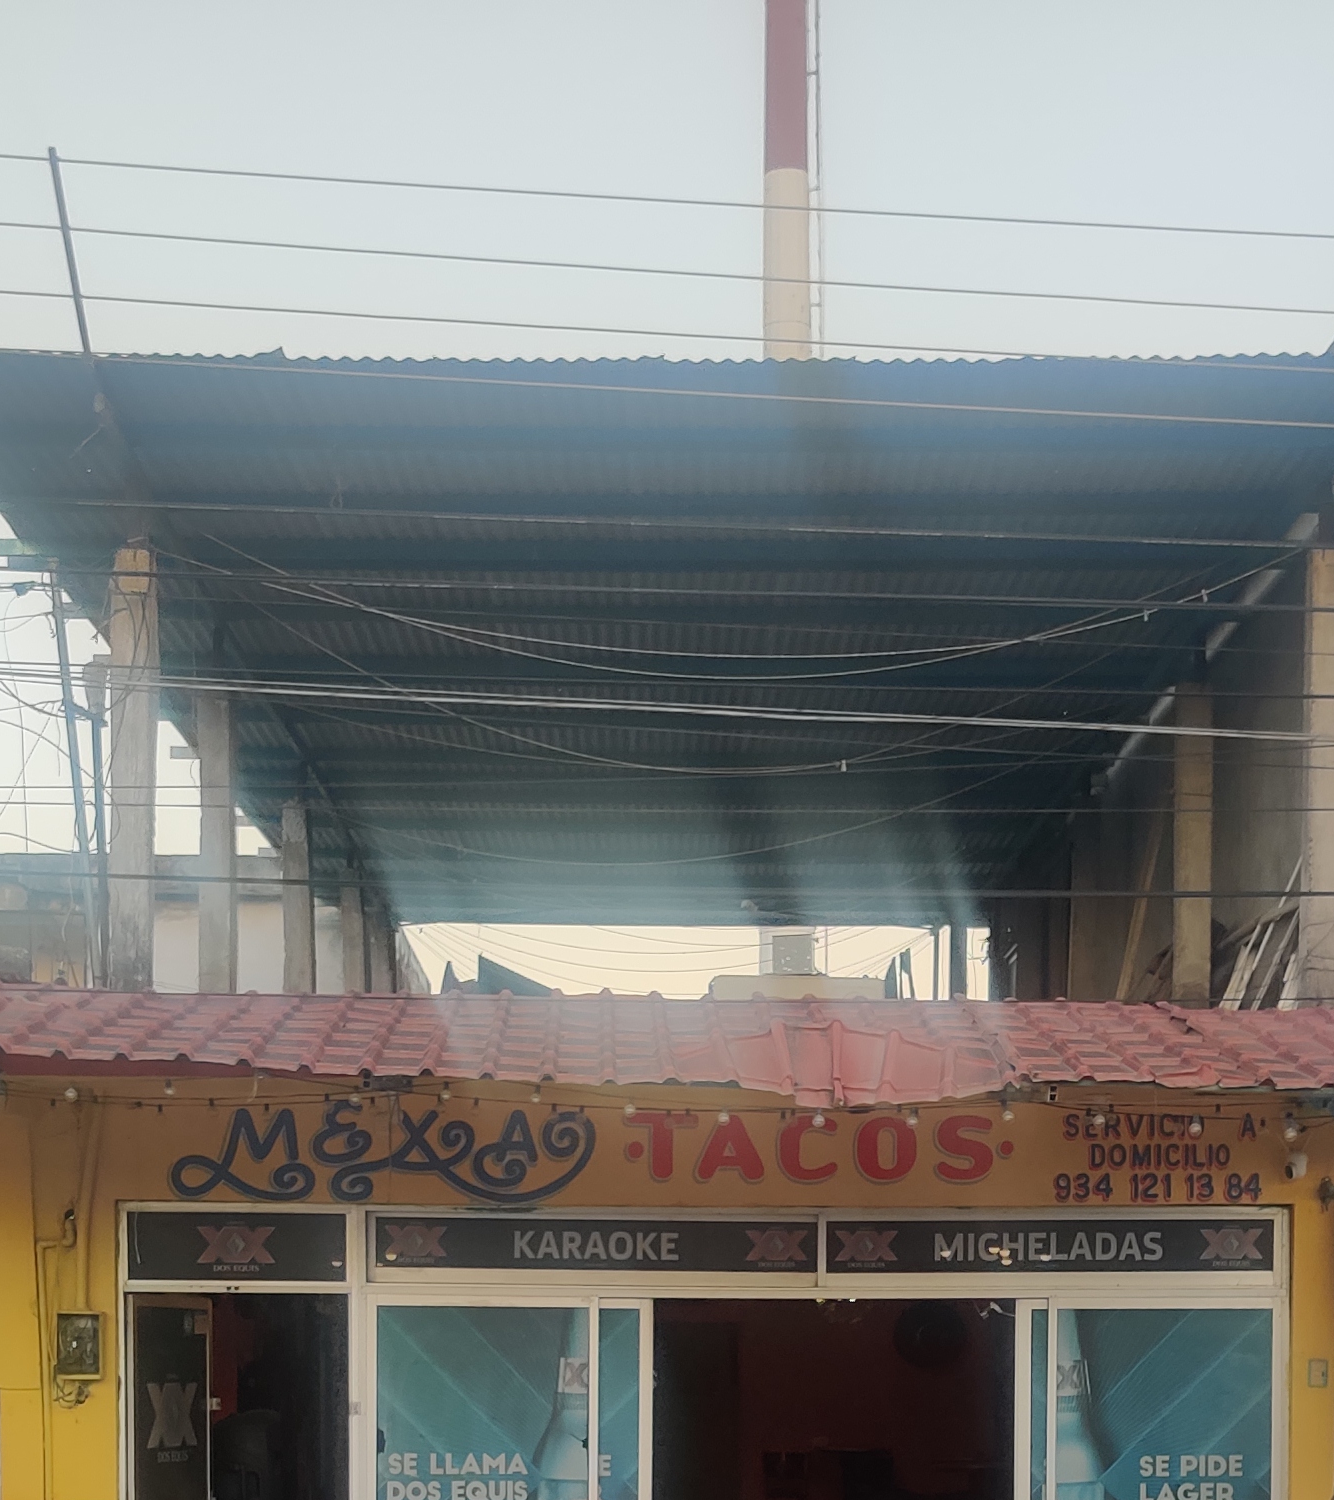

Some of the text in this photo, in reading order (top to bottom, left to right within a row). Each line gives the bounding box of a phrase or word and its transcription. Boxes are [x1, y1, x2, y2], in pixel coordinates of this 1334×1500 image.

[1063, 1113, 1205, 1140] SERVICIO
[623, 1113, 995, 1184] TACOS
[1088, 1143, 1231, 1171] DOMICILIO
[1054, 1172, 1262, 1204] 934 121 13 84
[513, 1230, 680, 1261] KARAOKE
[933, 1232, 1164, 1262] MICHELADAS
[388, 1452, 529, 1476] SE LLAMA
[1139, 1455, 1244, 1478] SE PIDE
